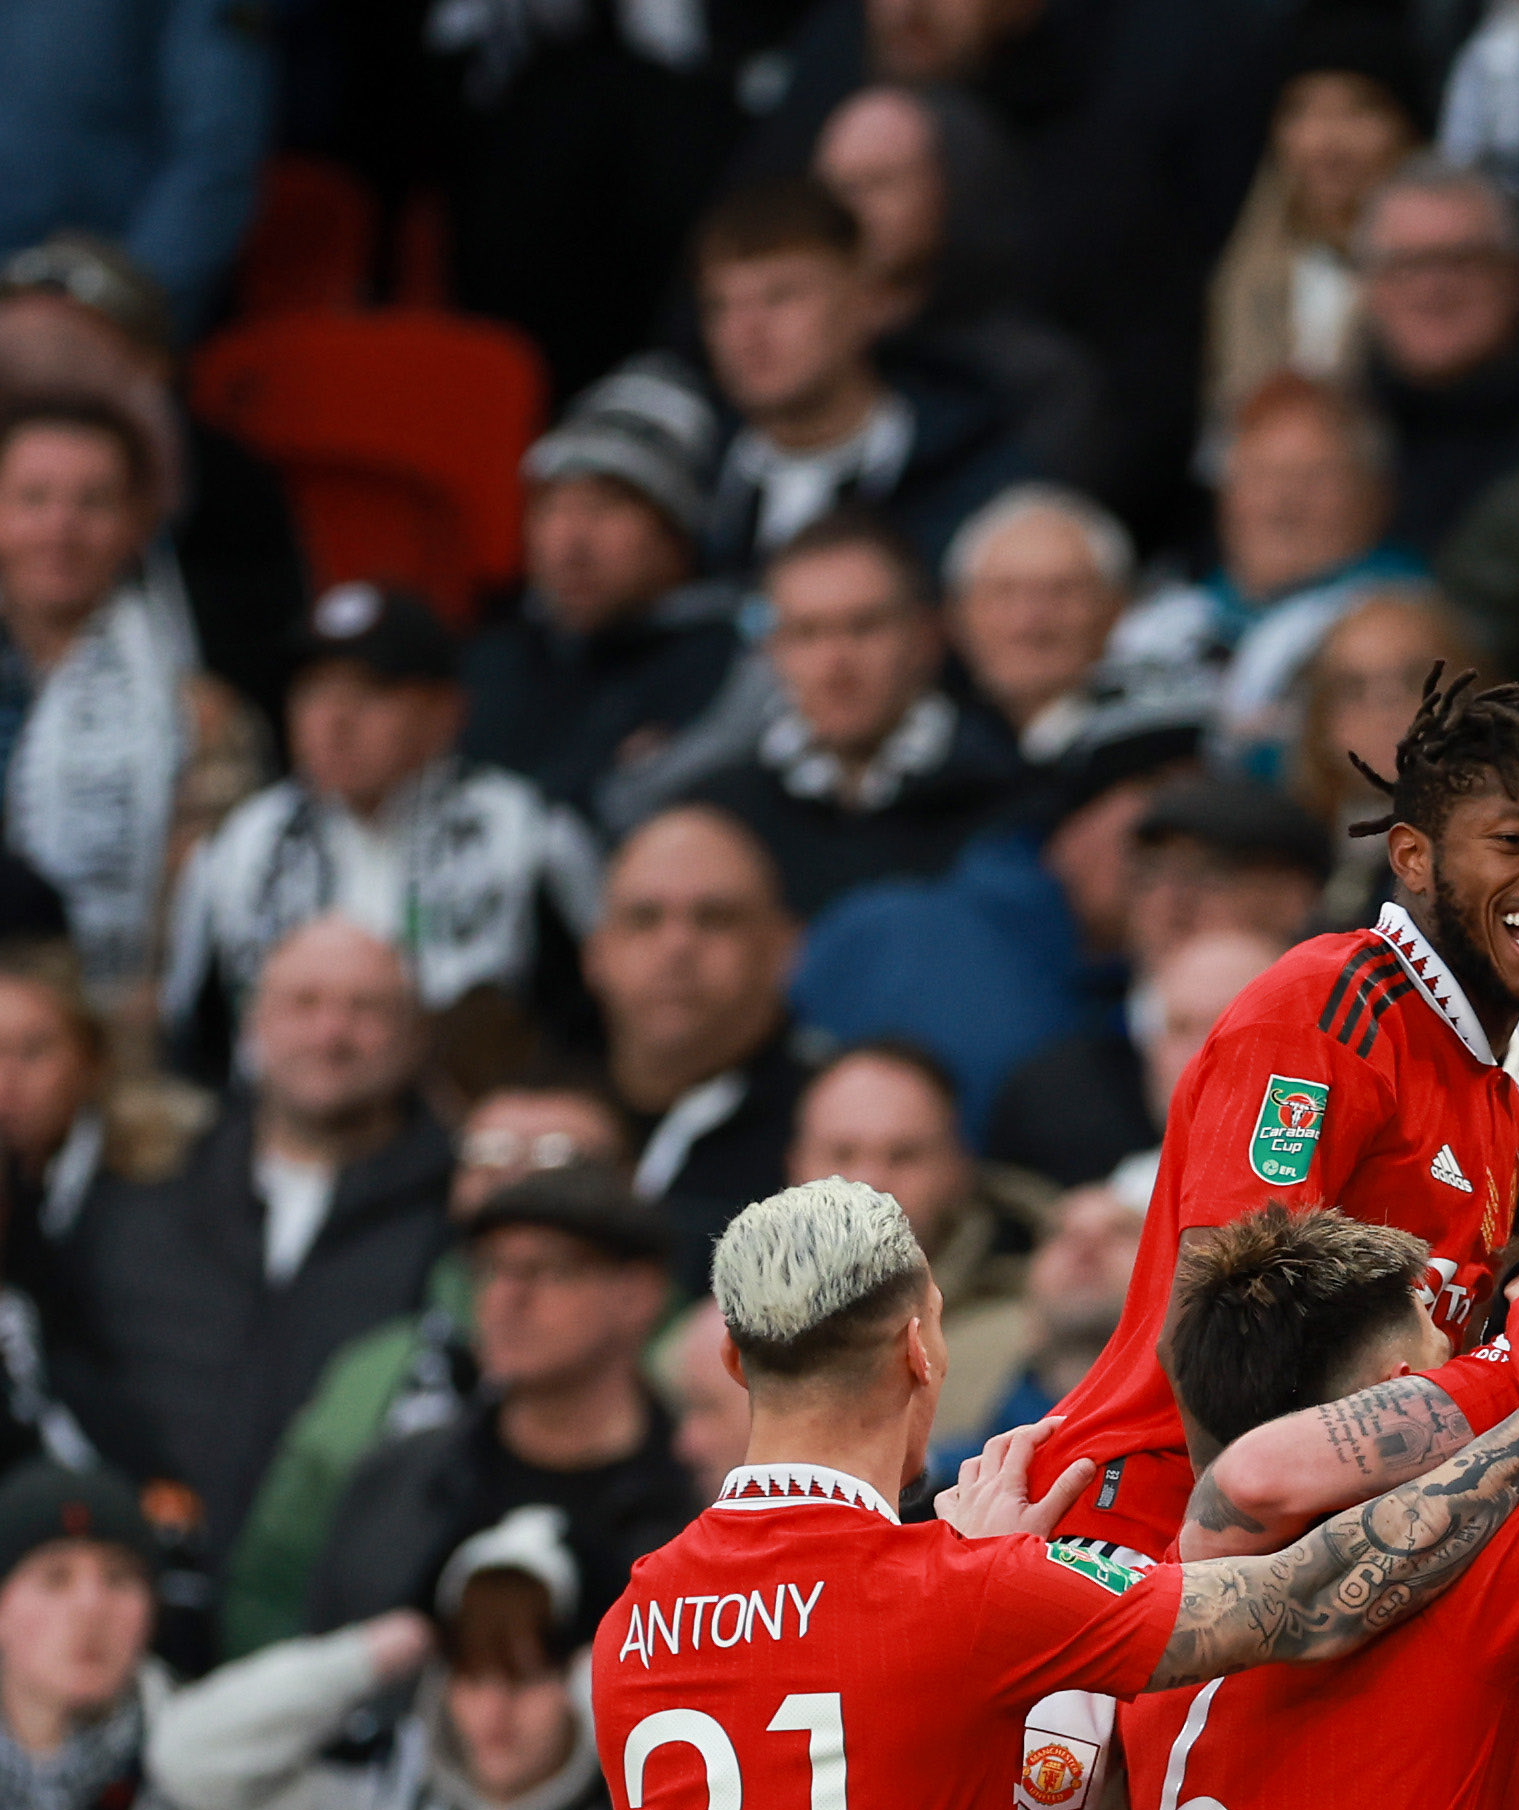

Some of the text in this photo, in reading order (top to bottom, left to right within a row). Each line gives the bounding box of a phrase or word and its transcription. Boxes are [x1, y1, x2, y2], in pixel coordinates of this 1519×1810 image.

[1271, 1138, 1303, 1155] Cup
[1278, 1165, 1297, 1178] EFL
[1430, 1165, 1474, 1193] adidas
[619, 1580, 825, 1669] ANTONY
